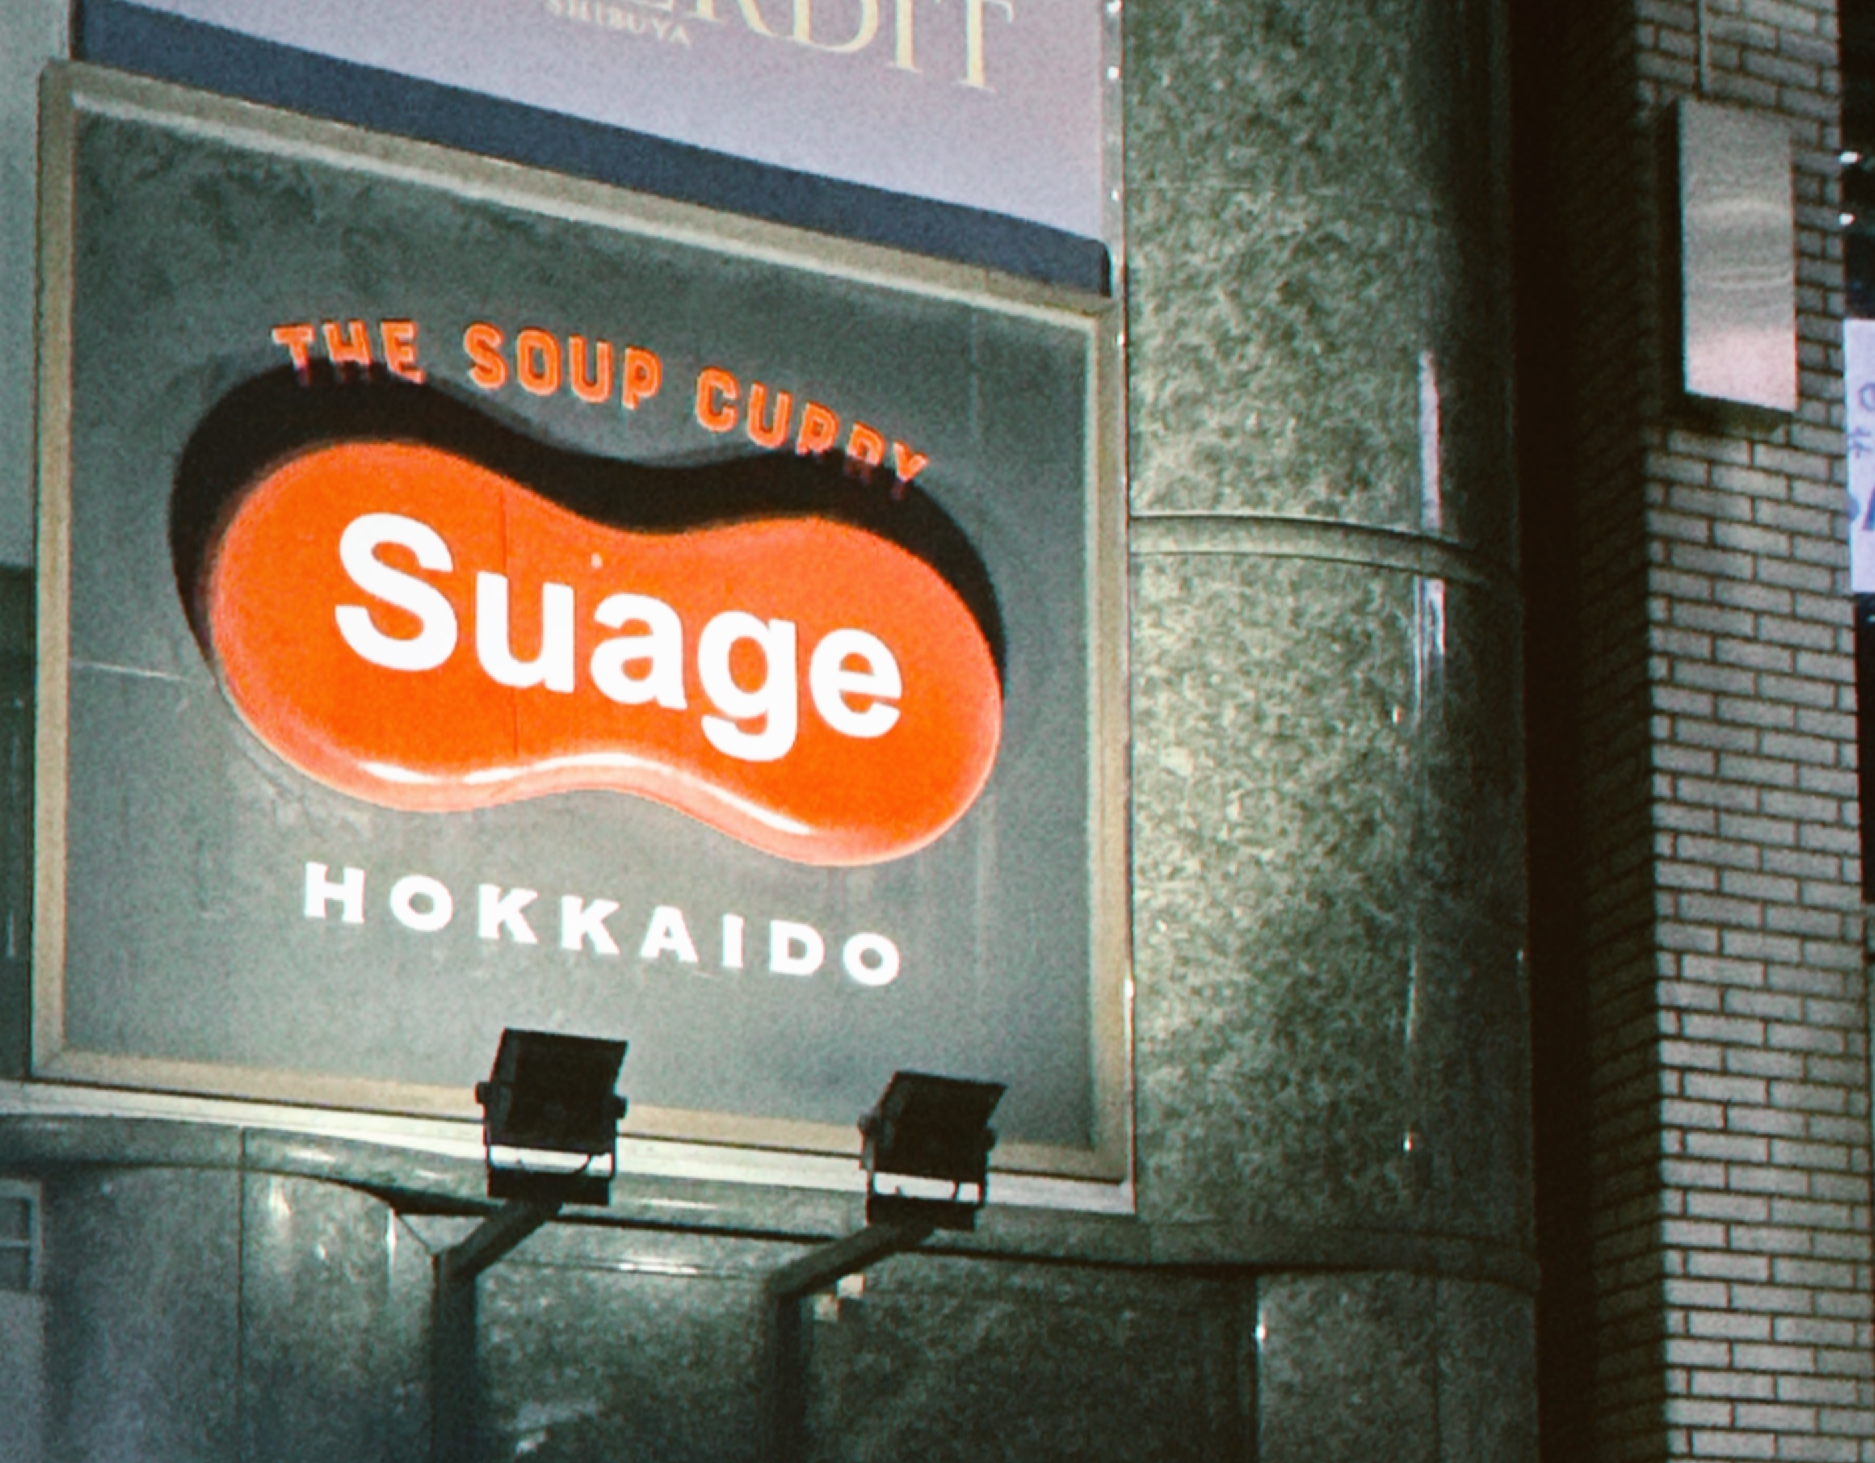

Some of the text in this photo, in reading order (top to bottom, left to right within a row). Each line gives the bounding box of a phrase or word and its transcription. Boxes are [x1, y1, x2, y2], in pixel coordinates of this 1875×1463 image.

[272, 319, 426, 386] THE
[464, 324, 663, 409] SOUP
[335, 512, 903, 762] Suage
[302, 862, 903, 988] HOKKAIDO
